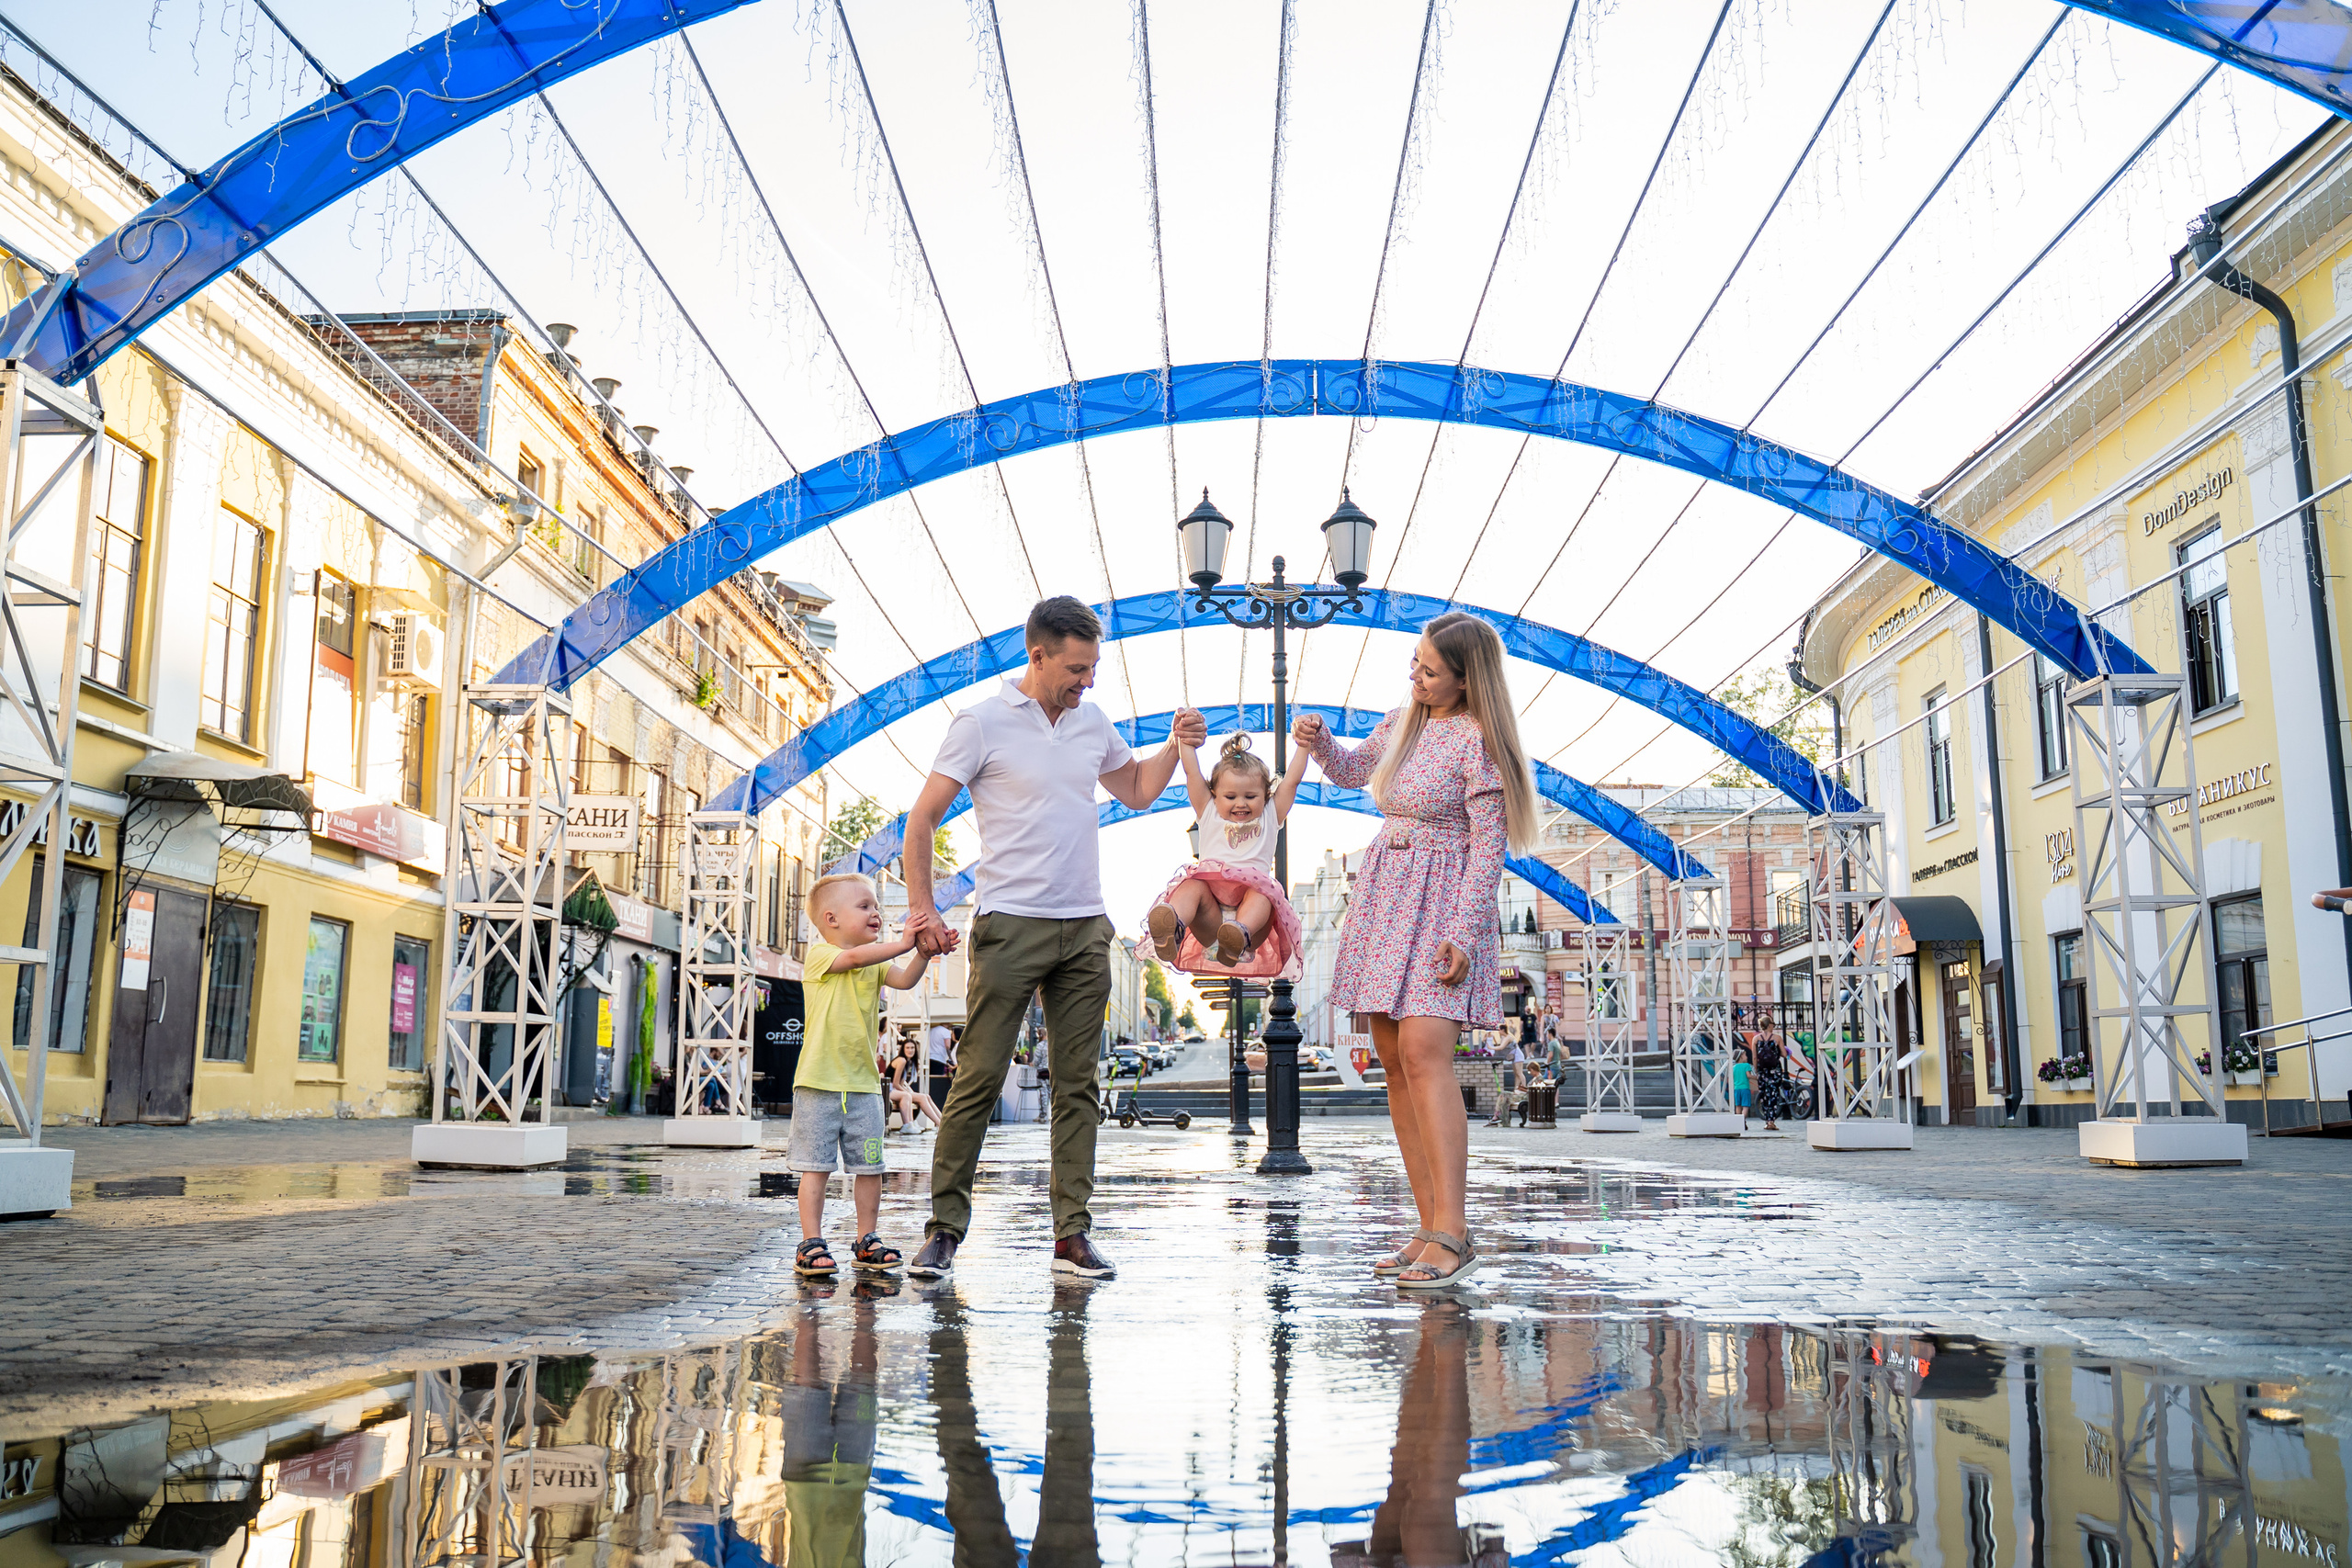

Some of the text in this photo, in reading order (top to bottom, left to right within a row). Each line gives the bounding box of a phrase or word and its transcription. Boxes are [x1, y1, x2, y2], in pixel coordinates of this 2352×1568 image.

[2143, 467, 2233, 536] DomDesign
[2167, 761, 2272, 817] БОАНИКУС
[2206, 807, 2236, 822] КОСМЕТИКА
[2243, 795, 2276, 811] ЭКОТОВАРЫ
[564, 830, 612, 839] пасской
[2043, 827, 2074, 863] 1304
[617, 898, 649, 928] ТКАНИ
[765, 1033, 809, 1043] OFFSH
[1337, 1034, 1369, 1047] КИРОВ
[1352, 1051, 1360, 1063] Я
